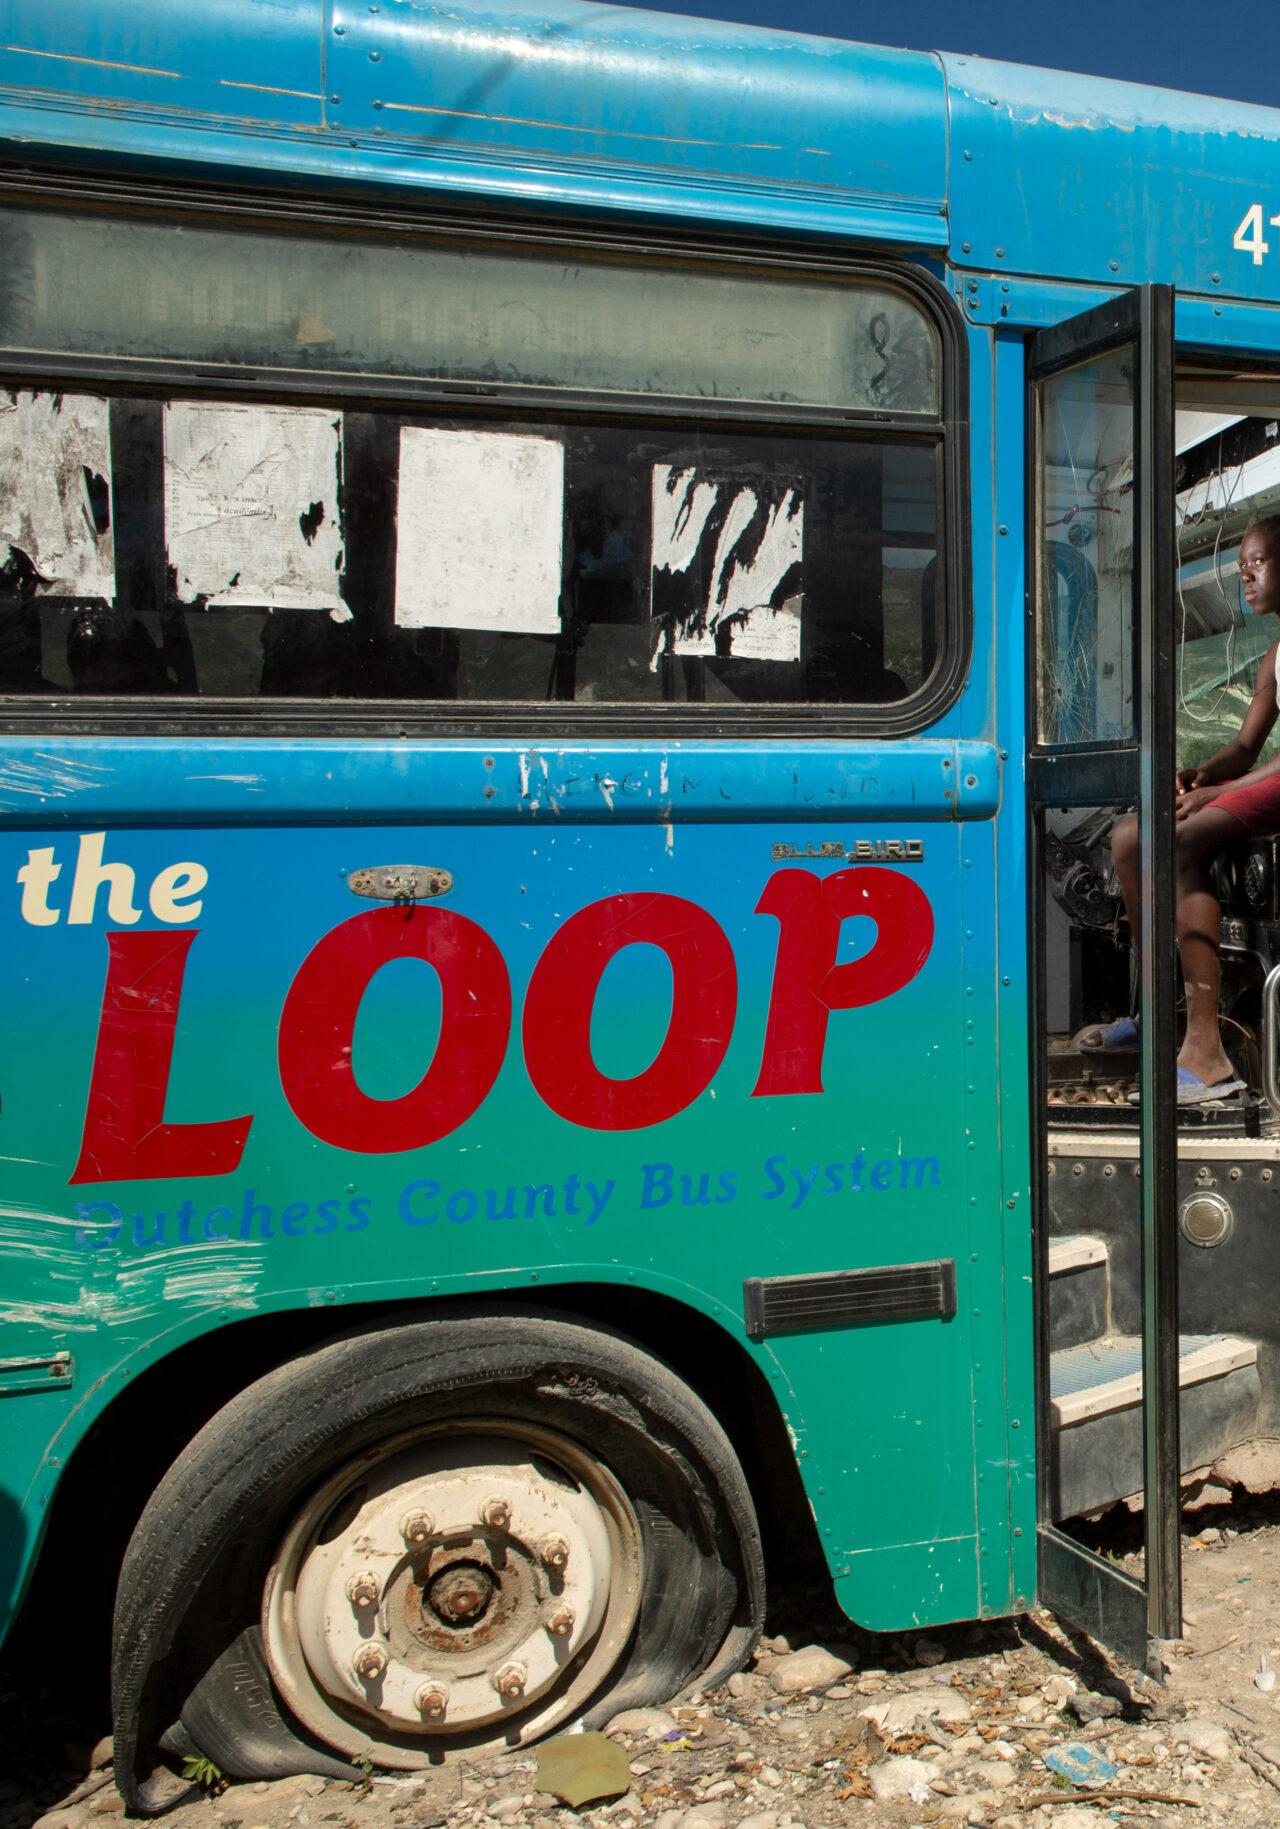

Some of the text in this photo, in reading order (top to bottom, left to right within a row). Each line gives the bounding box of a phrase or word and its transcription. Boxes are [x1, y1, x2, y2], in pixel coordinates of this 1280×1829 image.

[17, 831, 209, 927] the
[854, 839, 923, 857] BIRD
[68, 866, 935, 1185] LOOP
[74, 1153, 942, 1250] Dutchess County Bus System
